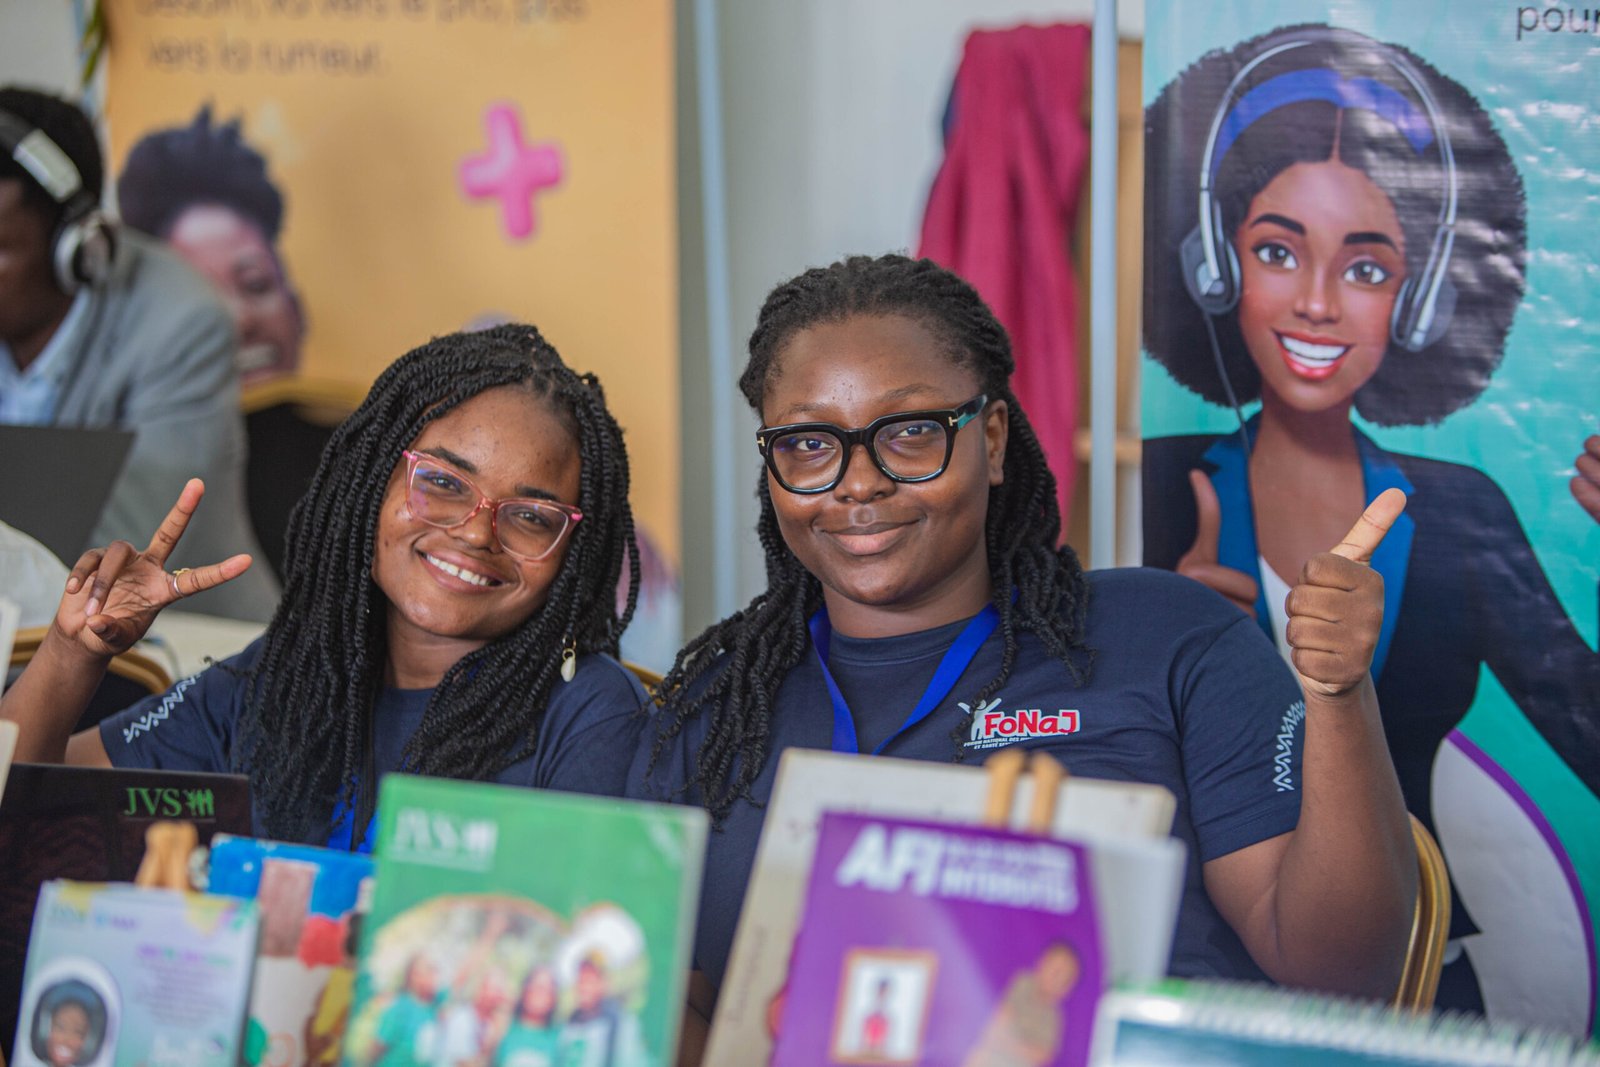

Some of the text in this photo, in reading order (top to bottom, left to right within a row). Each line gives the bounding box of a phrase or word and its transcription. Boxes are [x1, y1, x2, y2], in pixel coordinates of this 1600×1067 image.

[147, 40, 210, 73] vers
[983, 710, 1079, 737] FoNaJ
[123, 787, 182, 817] JVS
